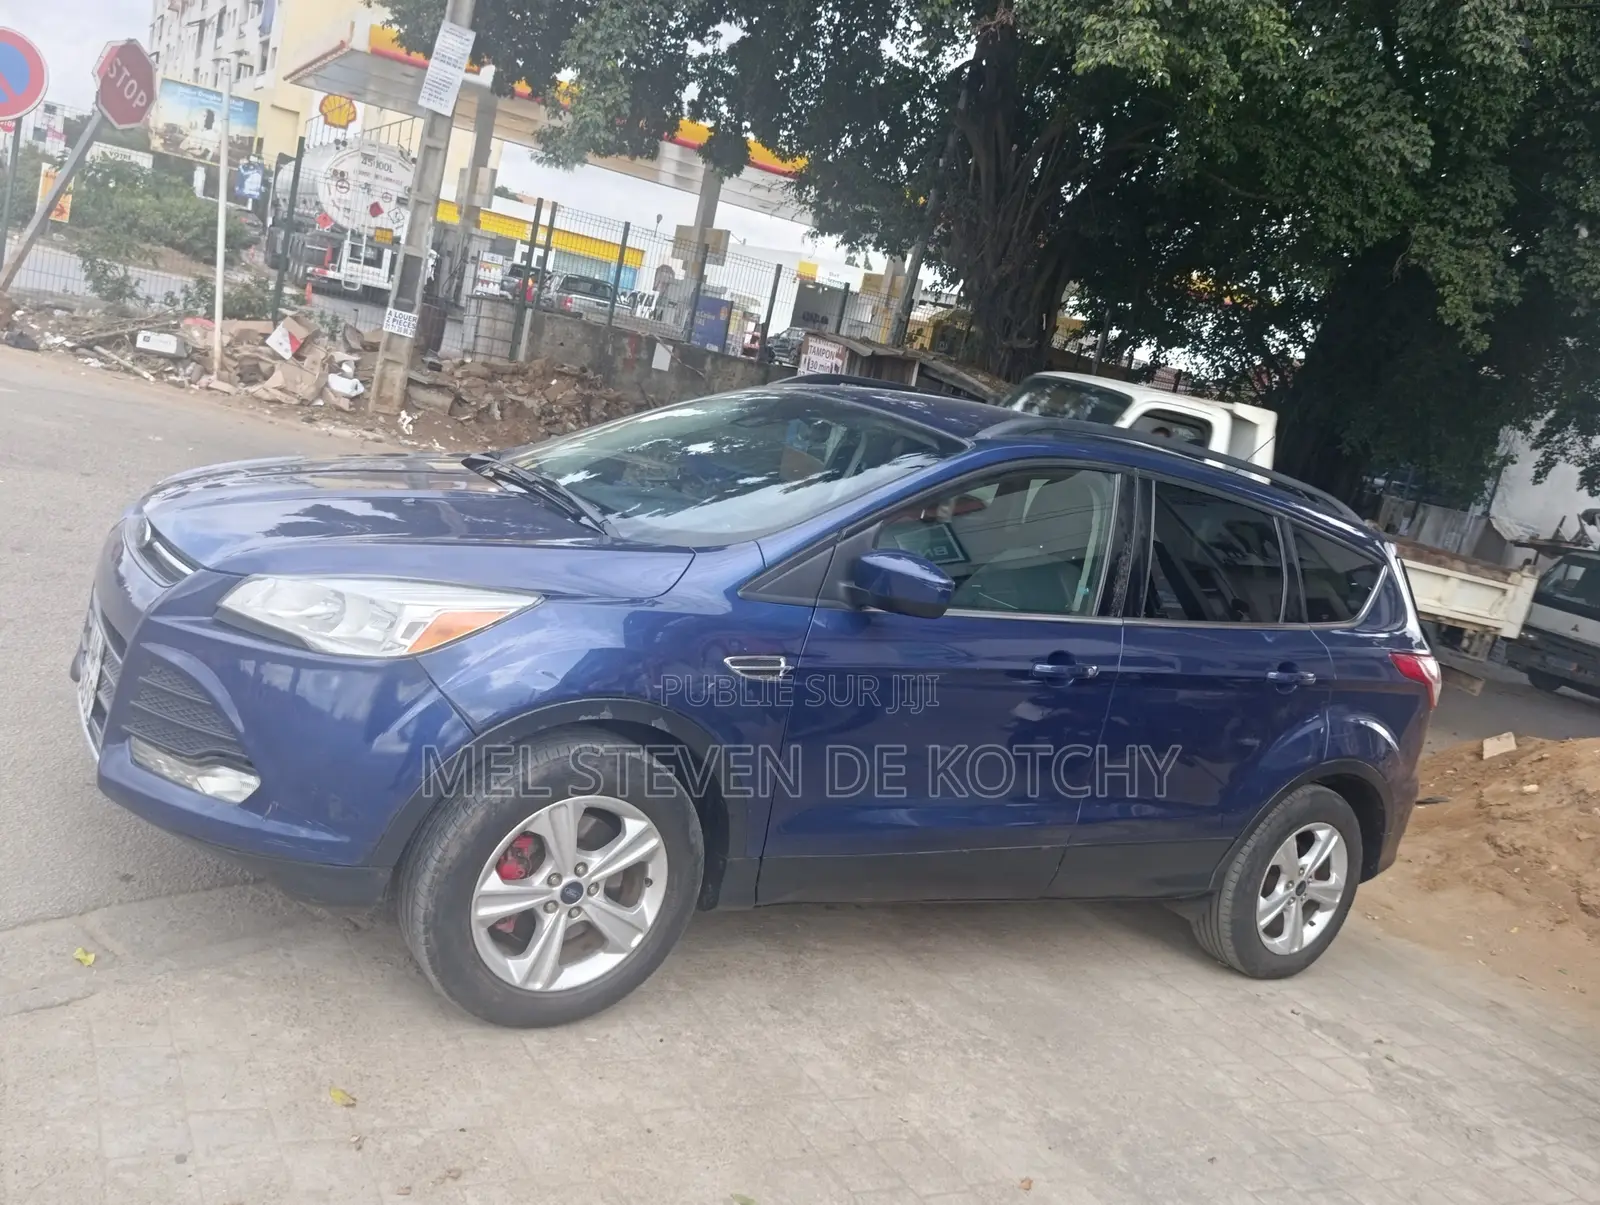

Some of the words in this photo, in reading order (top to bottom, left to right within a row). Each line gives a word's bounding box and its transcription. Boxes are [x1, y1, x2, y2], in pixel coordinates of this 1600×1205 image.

[107, 57, 147, 108] STOP
[394, 311, 417, 322] LOUER
[392, 318, 416, 330] PIECES
[809, 345, 836, 360] TAMPON
[810, 360, 819, 370] 30
